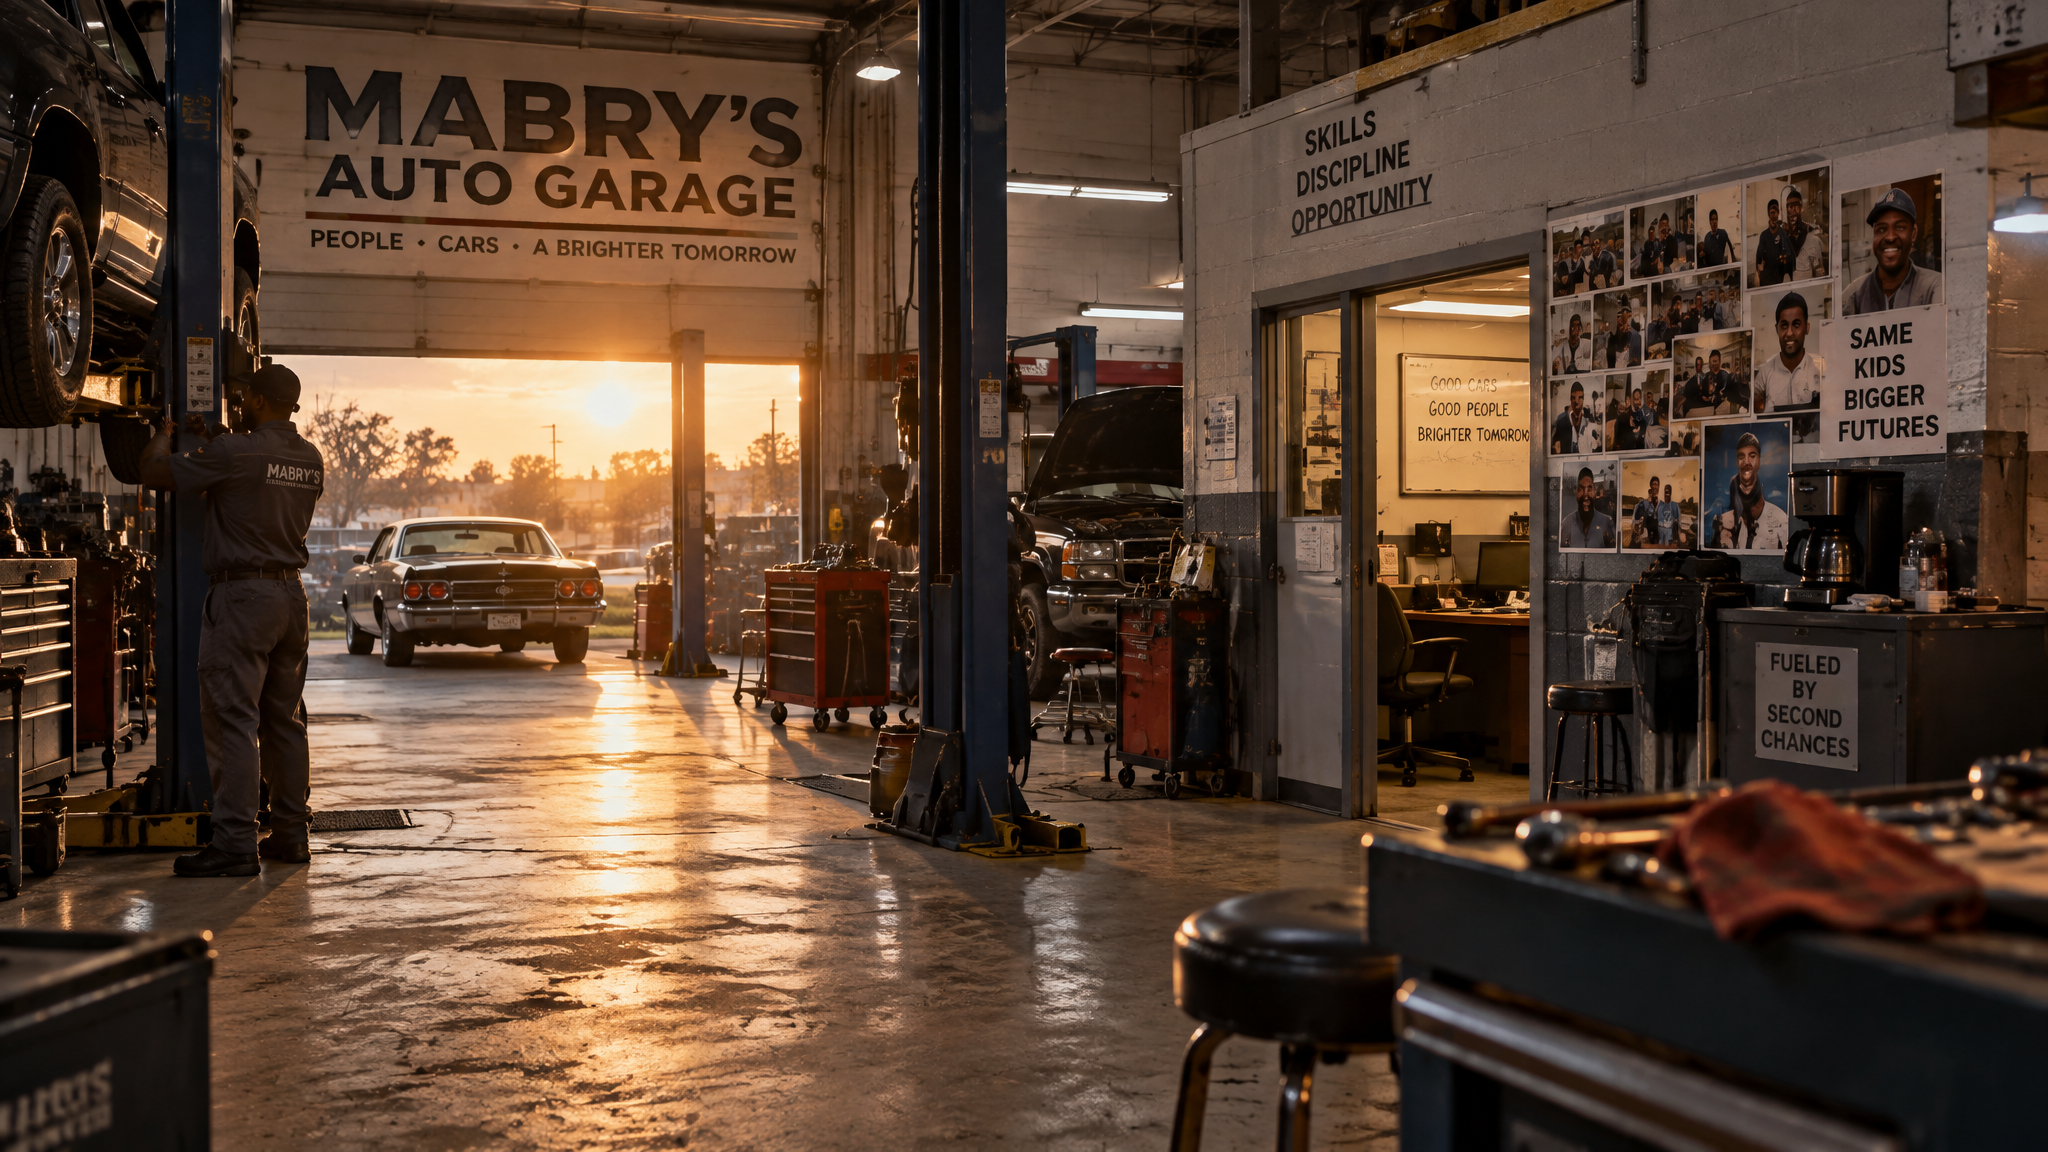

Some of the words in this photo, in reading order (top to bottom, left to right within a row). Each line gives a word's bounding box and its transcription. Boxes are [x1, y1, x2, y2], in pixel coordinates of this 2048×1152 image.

[305, 64, 802, 168] MABRY'S
[1305, 110, 1376, 156] SKILLS
[1296, 139, 1410, 198] DISCIPLINE
[315, 154, 512, 206] AUTO
[534, 164, 796, 218] GARAGE
[1291, 173, 1433, 235] OPPORTUNITY
[309, 228, 404, 251] PEOPLE
[437, 234, 499, 255] CARS
[532, 238, 549, 256] A
[556, 239, 664, 260] BRIGHTER
[671, 242, 797, 264] TOMORROW
[1850, 322, 1913, 350] SAME
[1854, 354, 1906, 379] KIDS
[1430, 375, 1462, 391] GOOD
[1428, 400, 1461, 416] GOOD
[1466, 402, 1509, 417] PEOPLE
[1844, 384, 1925, 410] BIGGER
[1418, 426, 1472, 442] BRIGHTER
[1838, 414, 1939, 442] FUTURES
[267, 463, 320, 485] MABRY'S
[1770, 652, 1841, 675] FUELED
[1792, 679, 1817, 700] BY
[1767, 703, 1842, 728] SECOND
[1761, 729, 1850, 758] CHANCES
